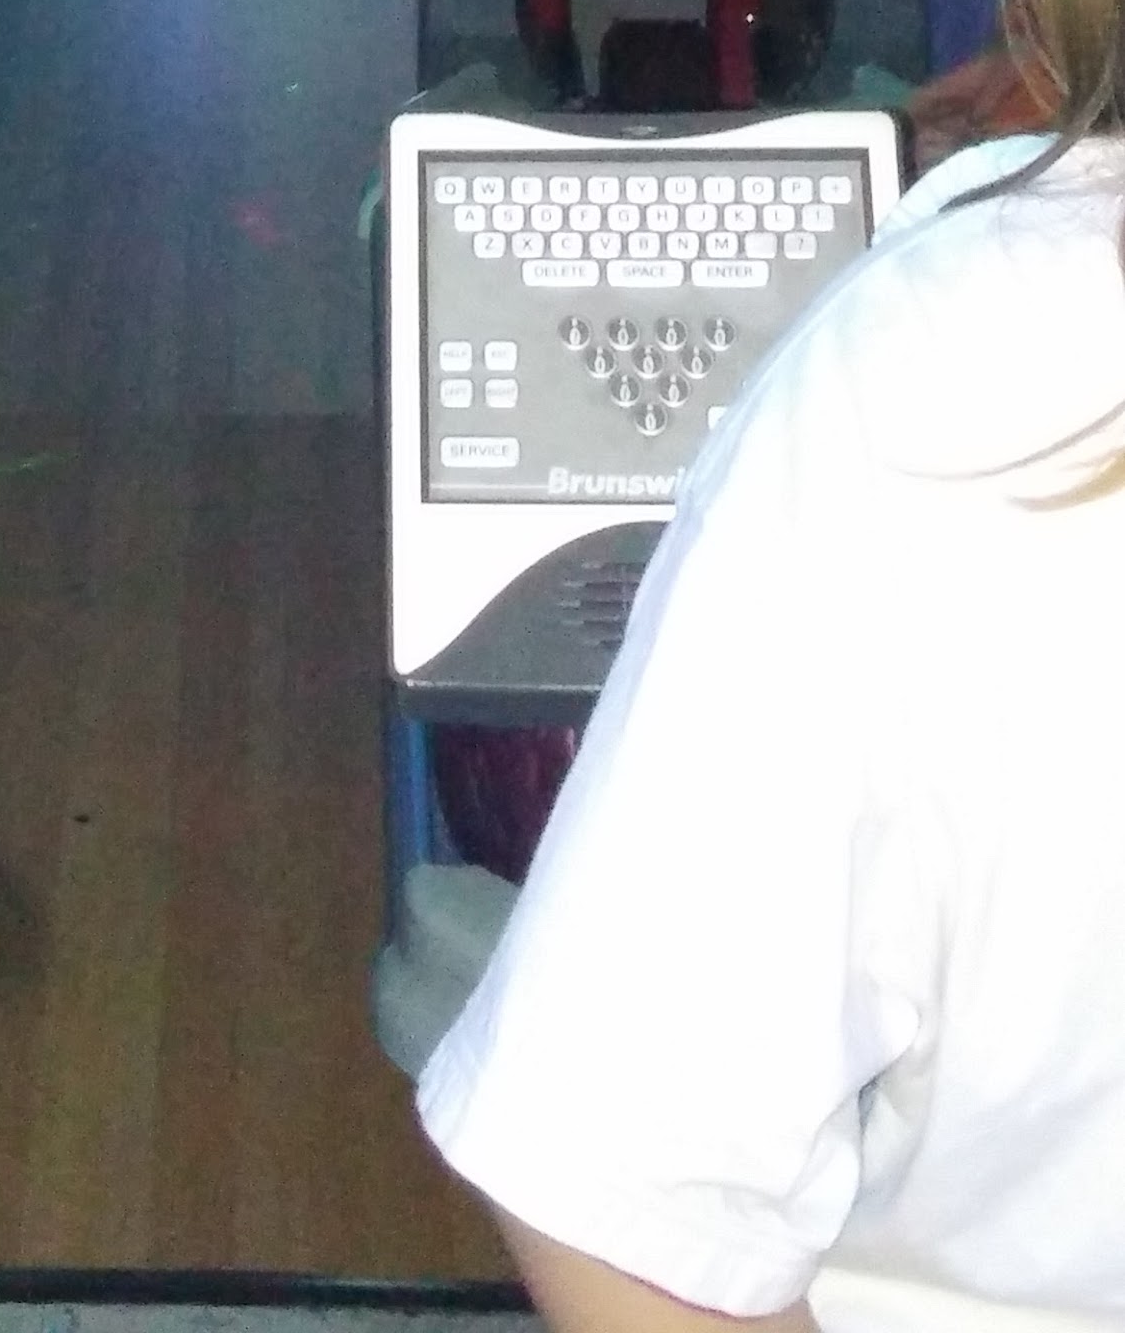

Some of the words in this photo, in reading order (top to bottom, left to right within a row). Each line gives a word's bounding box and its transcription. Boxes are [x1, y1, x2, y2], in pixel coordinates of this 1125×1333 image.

[534, 265, 586, 277] DELETE
[622, 265, 665, 278] SPACE
[706, 266, 754, 278] ENTER
[450, 444, 509, 457] SERVICE
[547, 465, 686, 495] Brunswi
